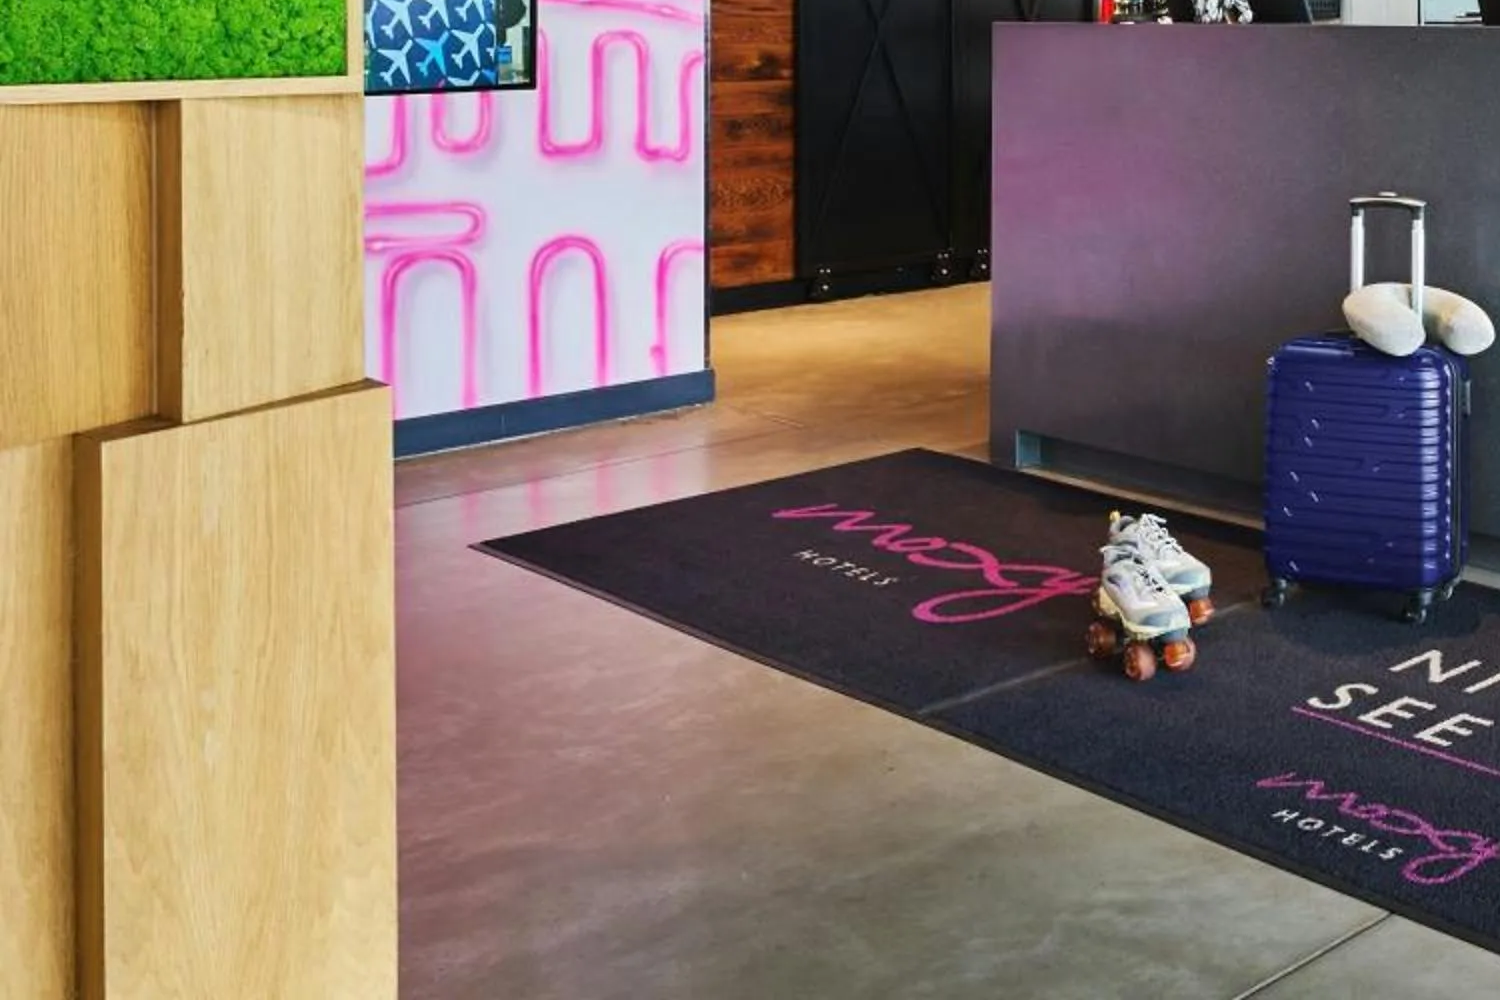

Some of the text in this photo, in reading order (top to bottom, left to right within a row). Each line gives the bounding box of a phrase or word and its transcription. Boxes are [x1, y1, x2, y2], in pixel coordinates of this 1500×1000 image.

[795, 548, 900, 587] HOTELS
[1306, 682, 1495, 747] SEE
[1271, 807, 1405, 862] HOTELS
